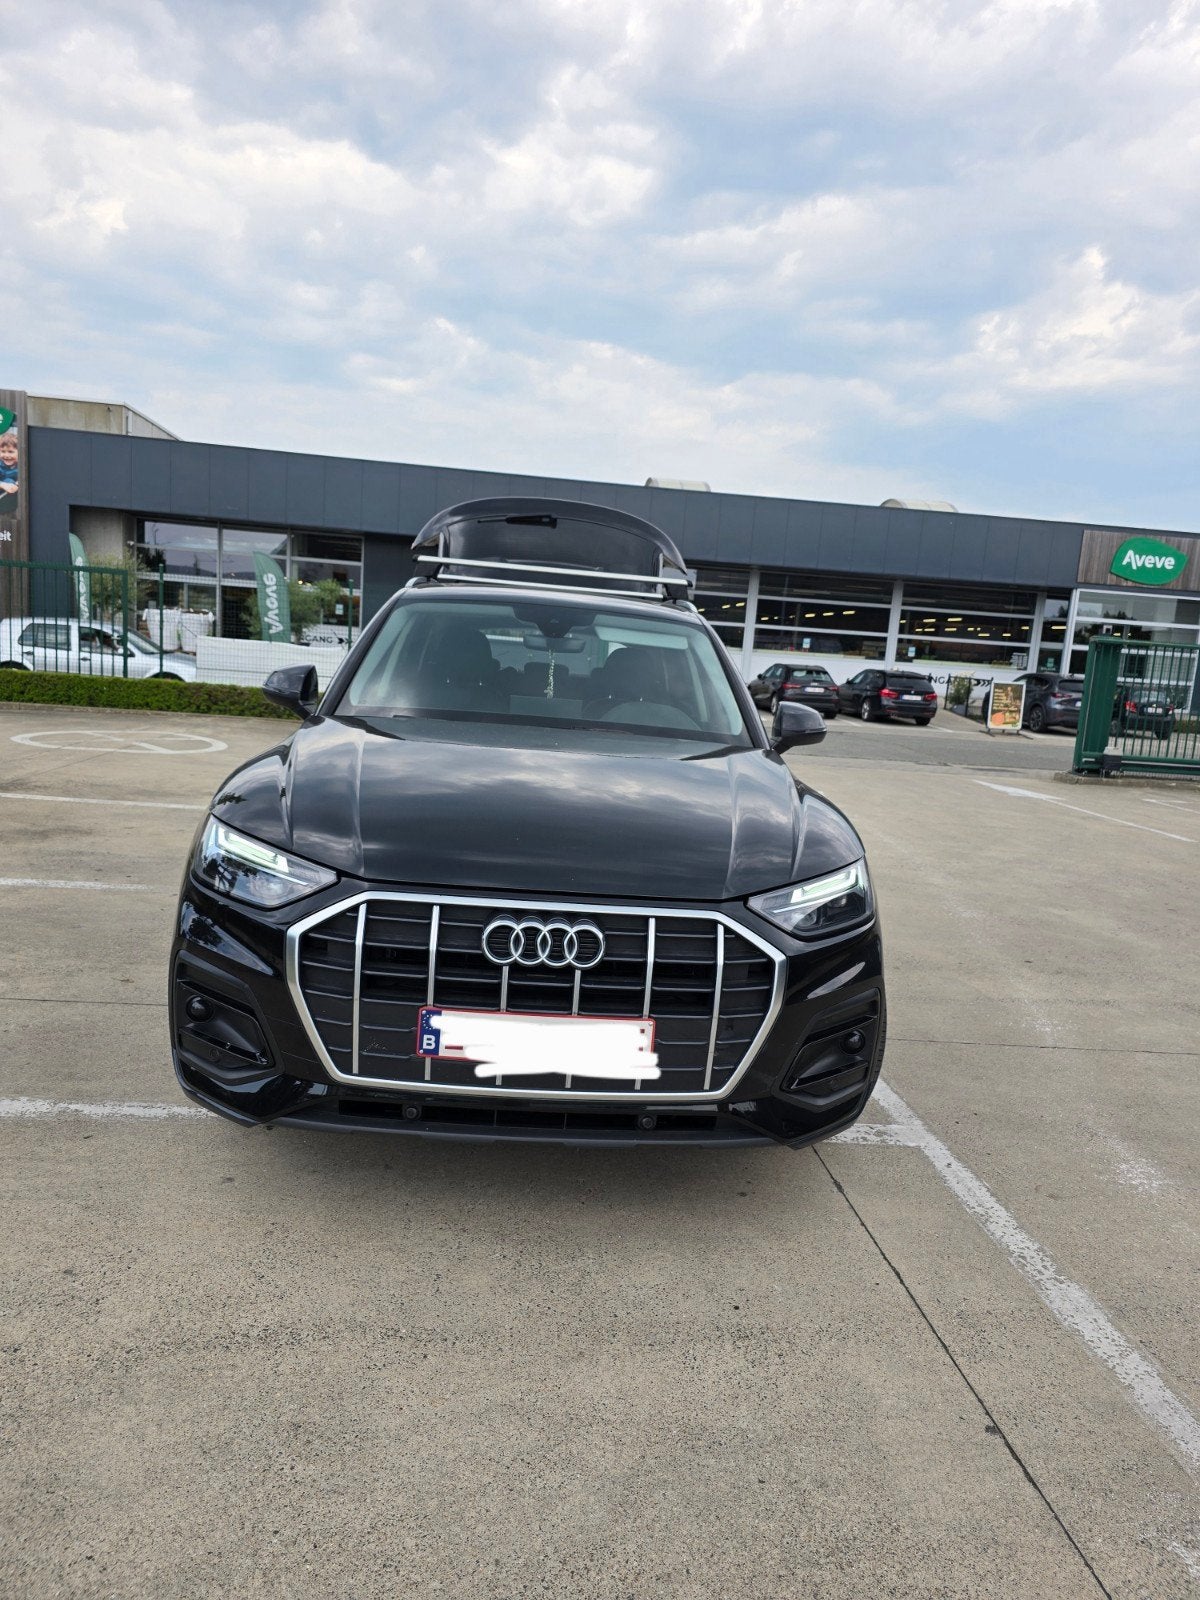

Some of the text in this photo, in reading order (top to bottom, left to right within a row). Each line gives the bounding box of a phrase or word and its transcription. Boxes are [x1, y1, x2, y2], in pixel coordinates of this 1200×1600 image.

[1122, 549, 1175, 570] Aveve
[263, 573, 283, 634] Aveve
[422, 1034, 436, 1049] B
